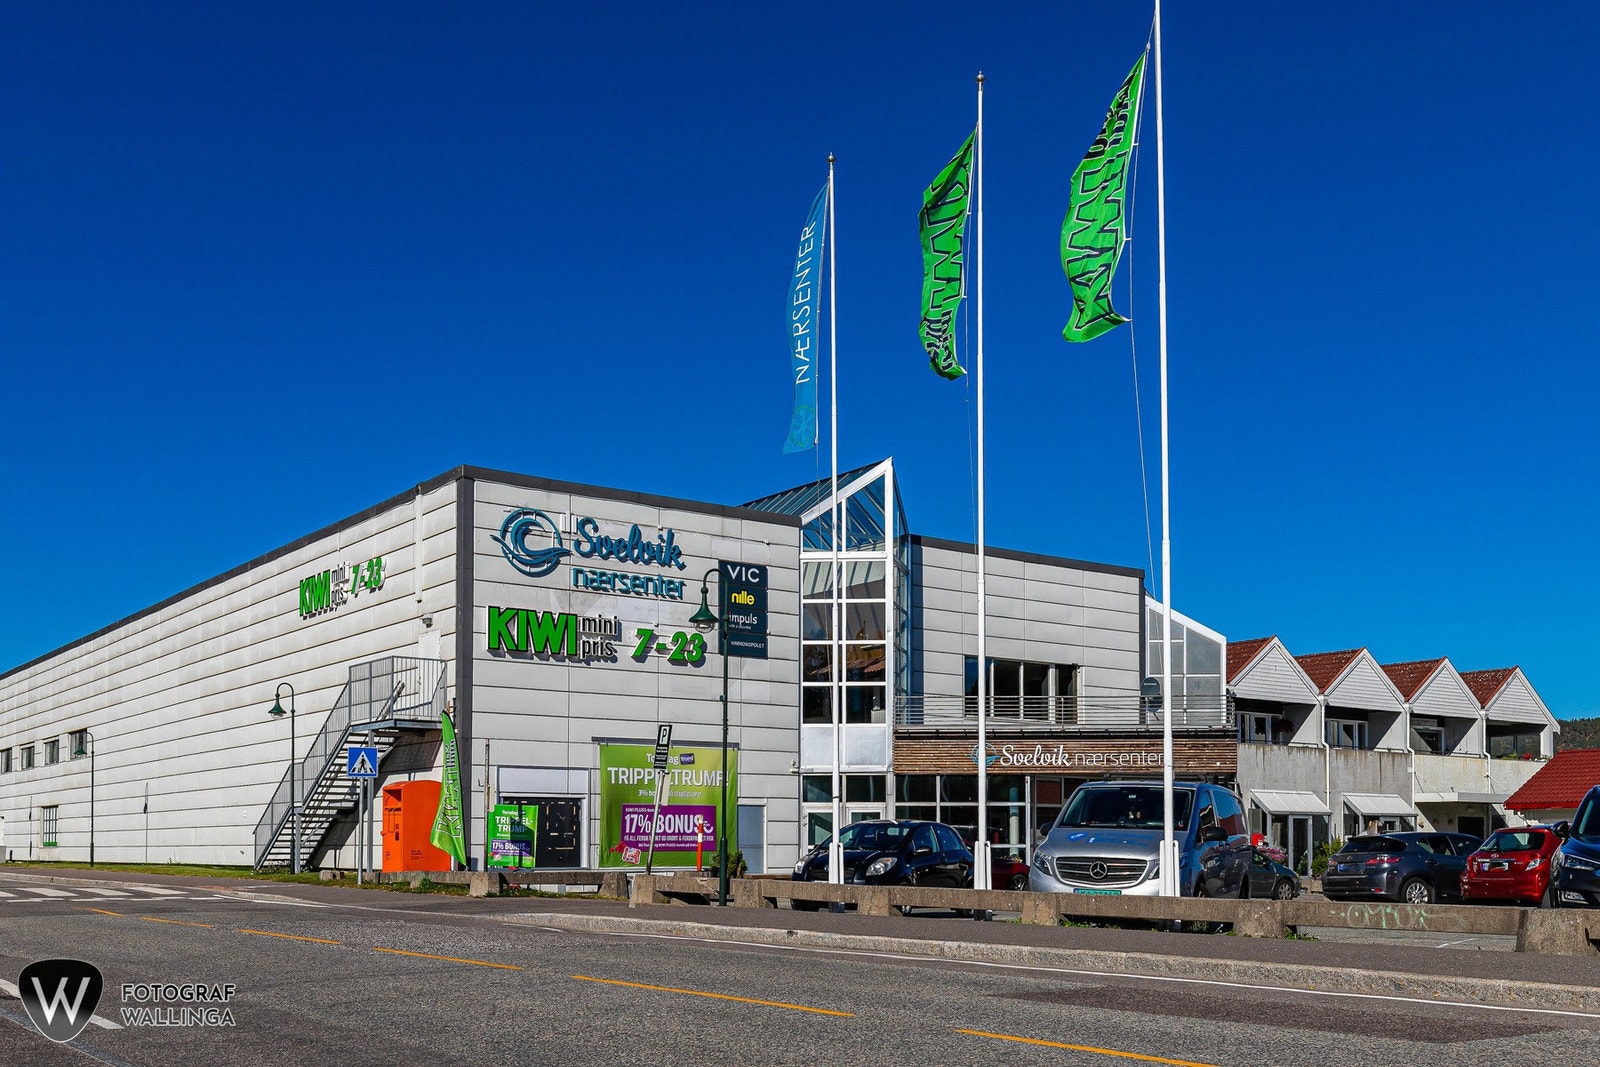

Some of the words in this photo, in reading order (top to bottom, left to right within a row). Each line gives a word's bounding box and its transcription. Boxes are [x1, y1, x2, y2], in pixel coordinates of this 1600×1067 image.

[792, 220, 817, 385] NÆRSENTER
[573, 516, 687, 571] Svelvik
[331, 561, 346, 584] mini
[573, 567, 687, 601] nærsenter
[727, 564, 760, 583] VIC
[300, 569, 331, 617] KIWI
[331, 586, 344, 607] pris
[731, 590, 755, 605] nille
[581, 613, 618, 636] mini
[728, 611, 758, 626] impuls
[487, 605, 578, 657] KIWI
[581, 636, 615, 660] pris
[661, 728, 668, 743] P
[646, 753, 679, 766] Toag
[999, 744, 1072, 767] Svelvik
[1075, 750, 1165, 766] nærsenter
[624, 814, 651, 834] 17%
